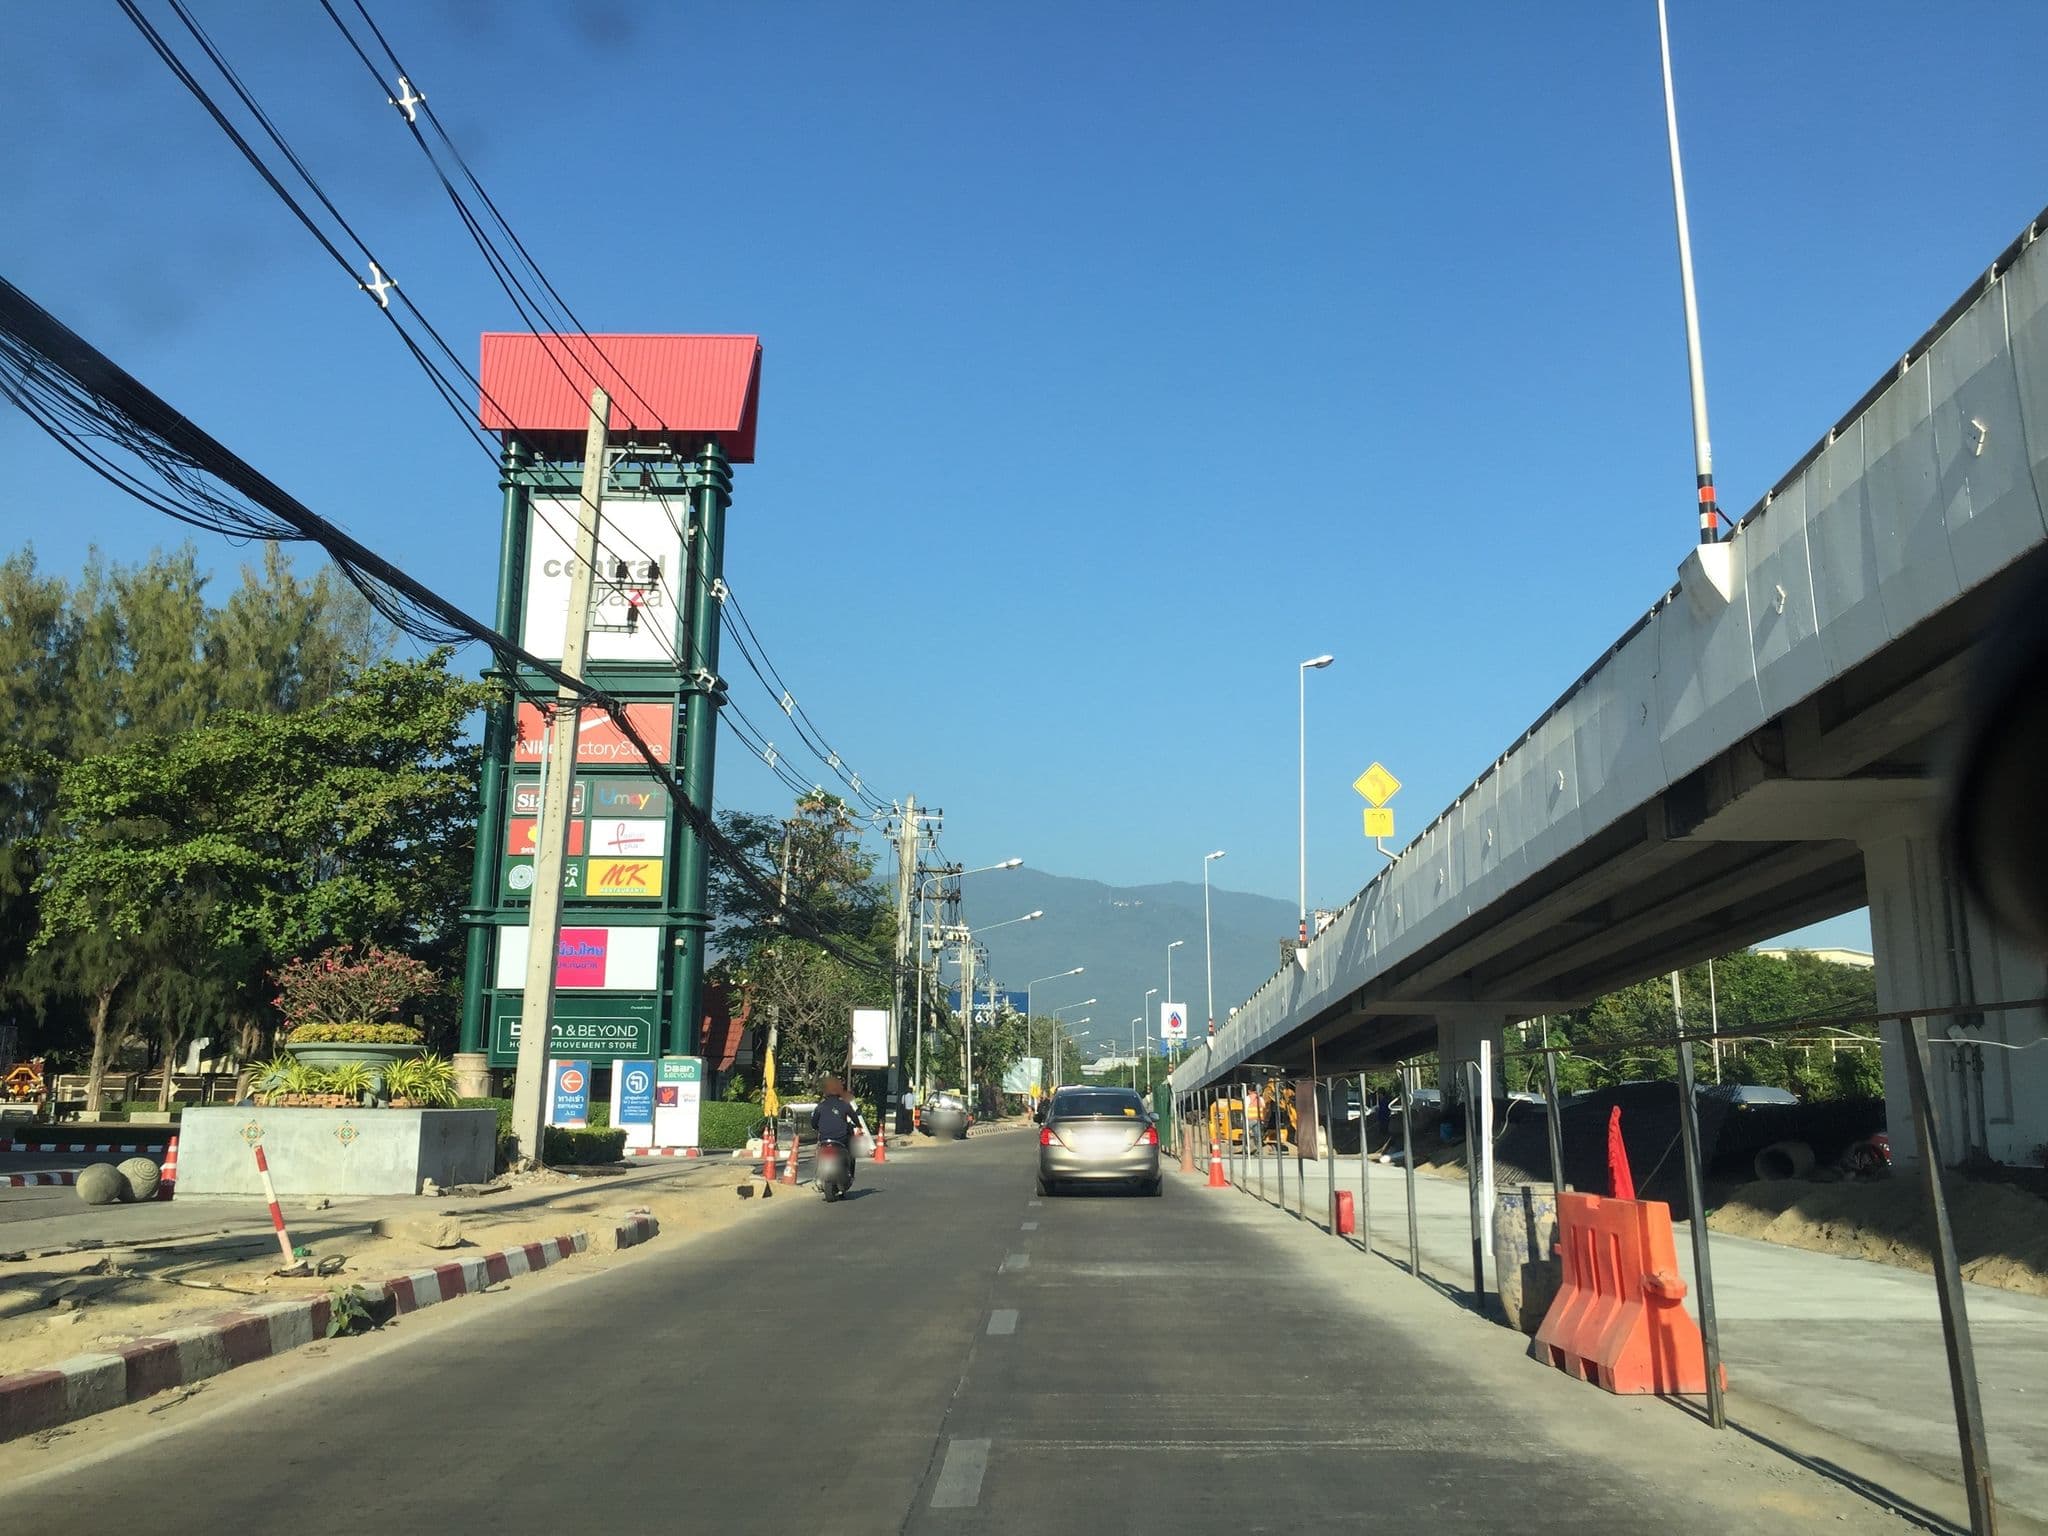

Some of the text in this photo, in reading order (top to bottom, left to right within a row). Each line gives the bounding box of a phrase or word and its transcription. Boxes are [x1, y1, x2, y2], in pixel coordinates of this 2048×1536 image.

[600, 863, 648, 886] MK
[510, 1021, 563, 1037] bn
[550, 1041, 606, 1049] PROVEMENT
[608, 1041, 638, 1049] STORE
